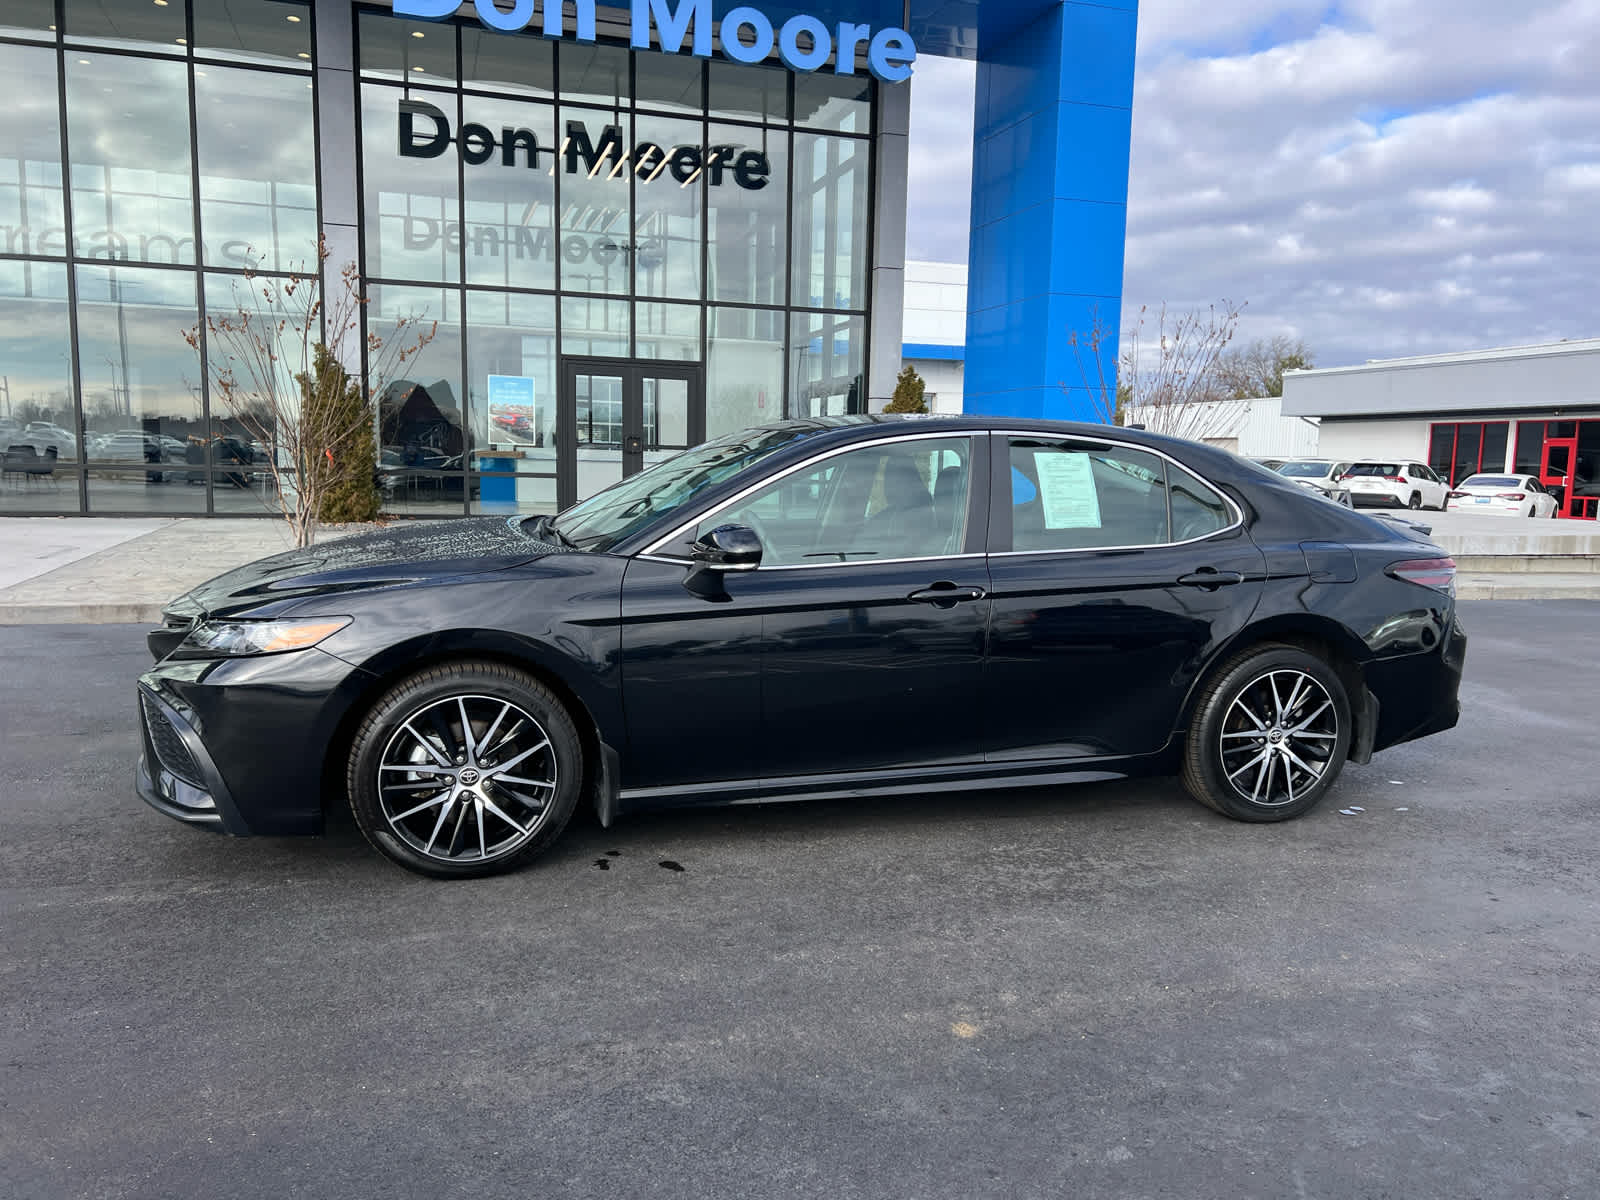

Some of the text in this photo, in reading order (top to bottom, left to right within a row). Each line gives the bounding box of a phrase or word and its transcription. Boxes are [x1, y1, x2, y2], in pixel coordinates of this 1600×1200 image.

[392, 0, 917, 83] on Moore
[398, 98, 770, 190] Don Moore
[403, 216, 500, 257] Don
